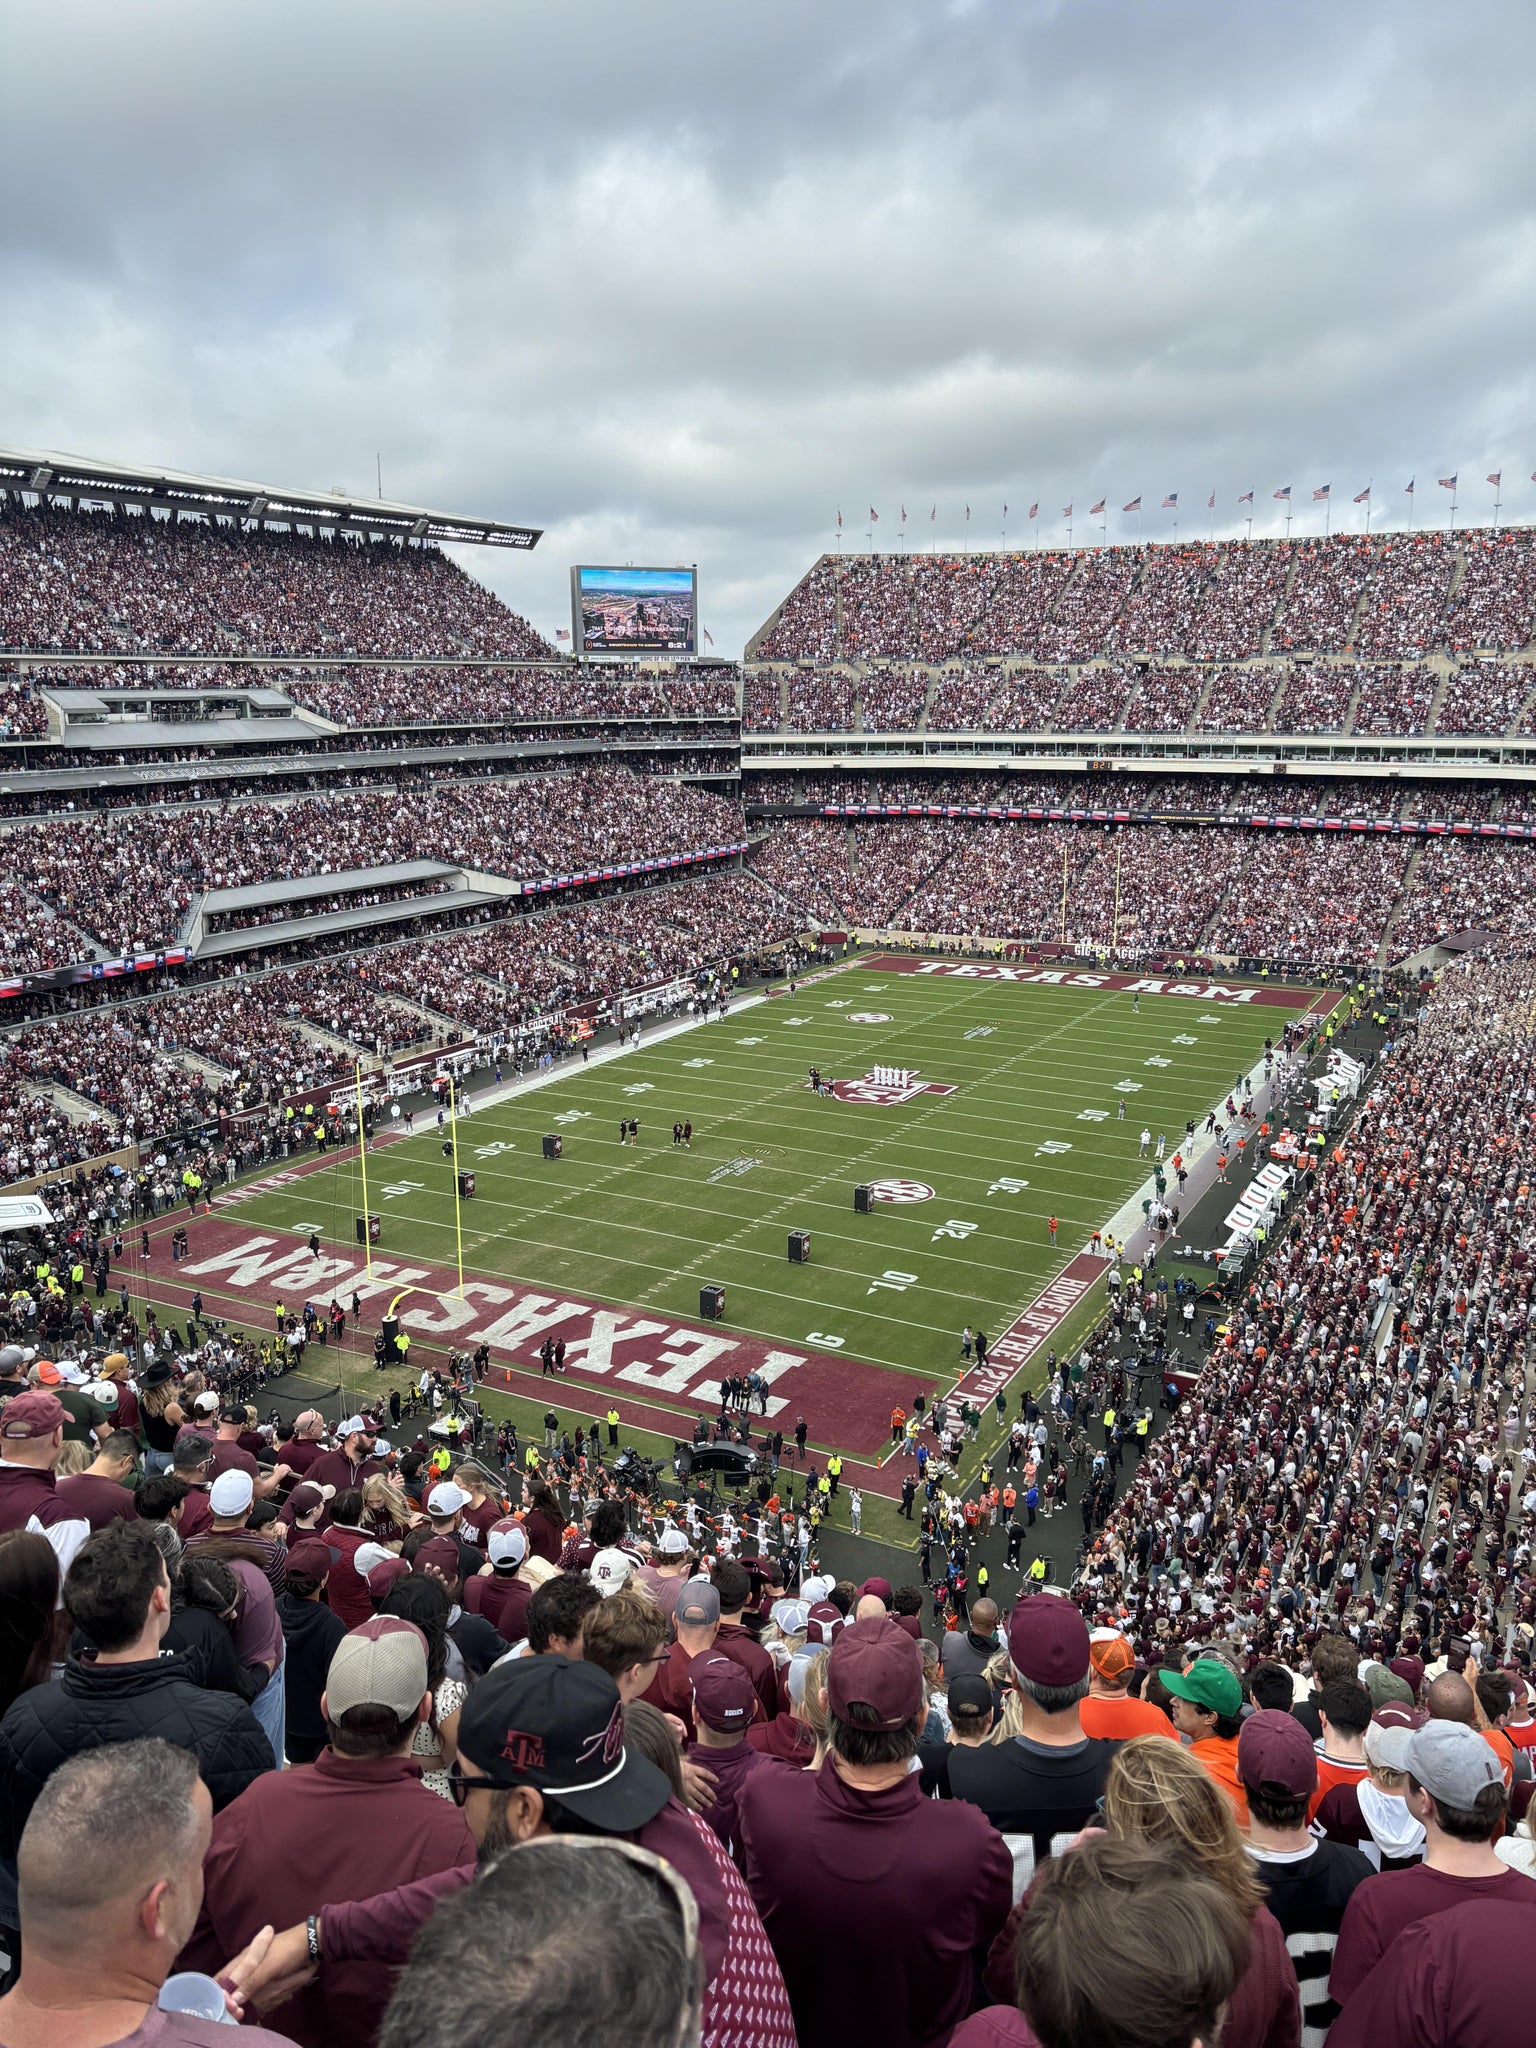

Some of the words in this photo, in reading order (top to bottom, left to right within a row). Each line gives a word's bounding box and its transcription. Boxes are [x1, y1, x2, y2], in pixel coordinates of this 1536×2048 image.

[1074, 945, 1091, 956] GIG
[914, 961, 1112, 987] TEXAS
[1121, 979, 1262, 1002] A&M
[1076, 1109, 1111, 1121] 50
[473, 1141, 516, 1156] 20
[1037, 1140, 1073, 1154] 40
[380, 1180, 425, 1195] 10
[989, 1176, 1030, 1194] 30
[935, 1219, 979, 1240] 20
[179, 1236, 432, 1310] A&M
[871, 1270, 919, 1292] 10
[1034, 1276, 1090, 1314] HOME
[1020, 1311, 1058, 1333] OF
[399, 1281, 809, 1418] TEXAS
[805, 1332, 846, 1348] G
[990, 1331, 1043, 1362] THE
[1497, 1566, 1507, 1577] 12
